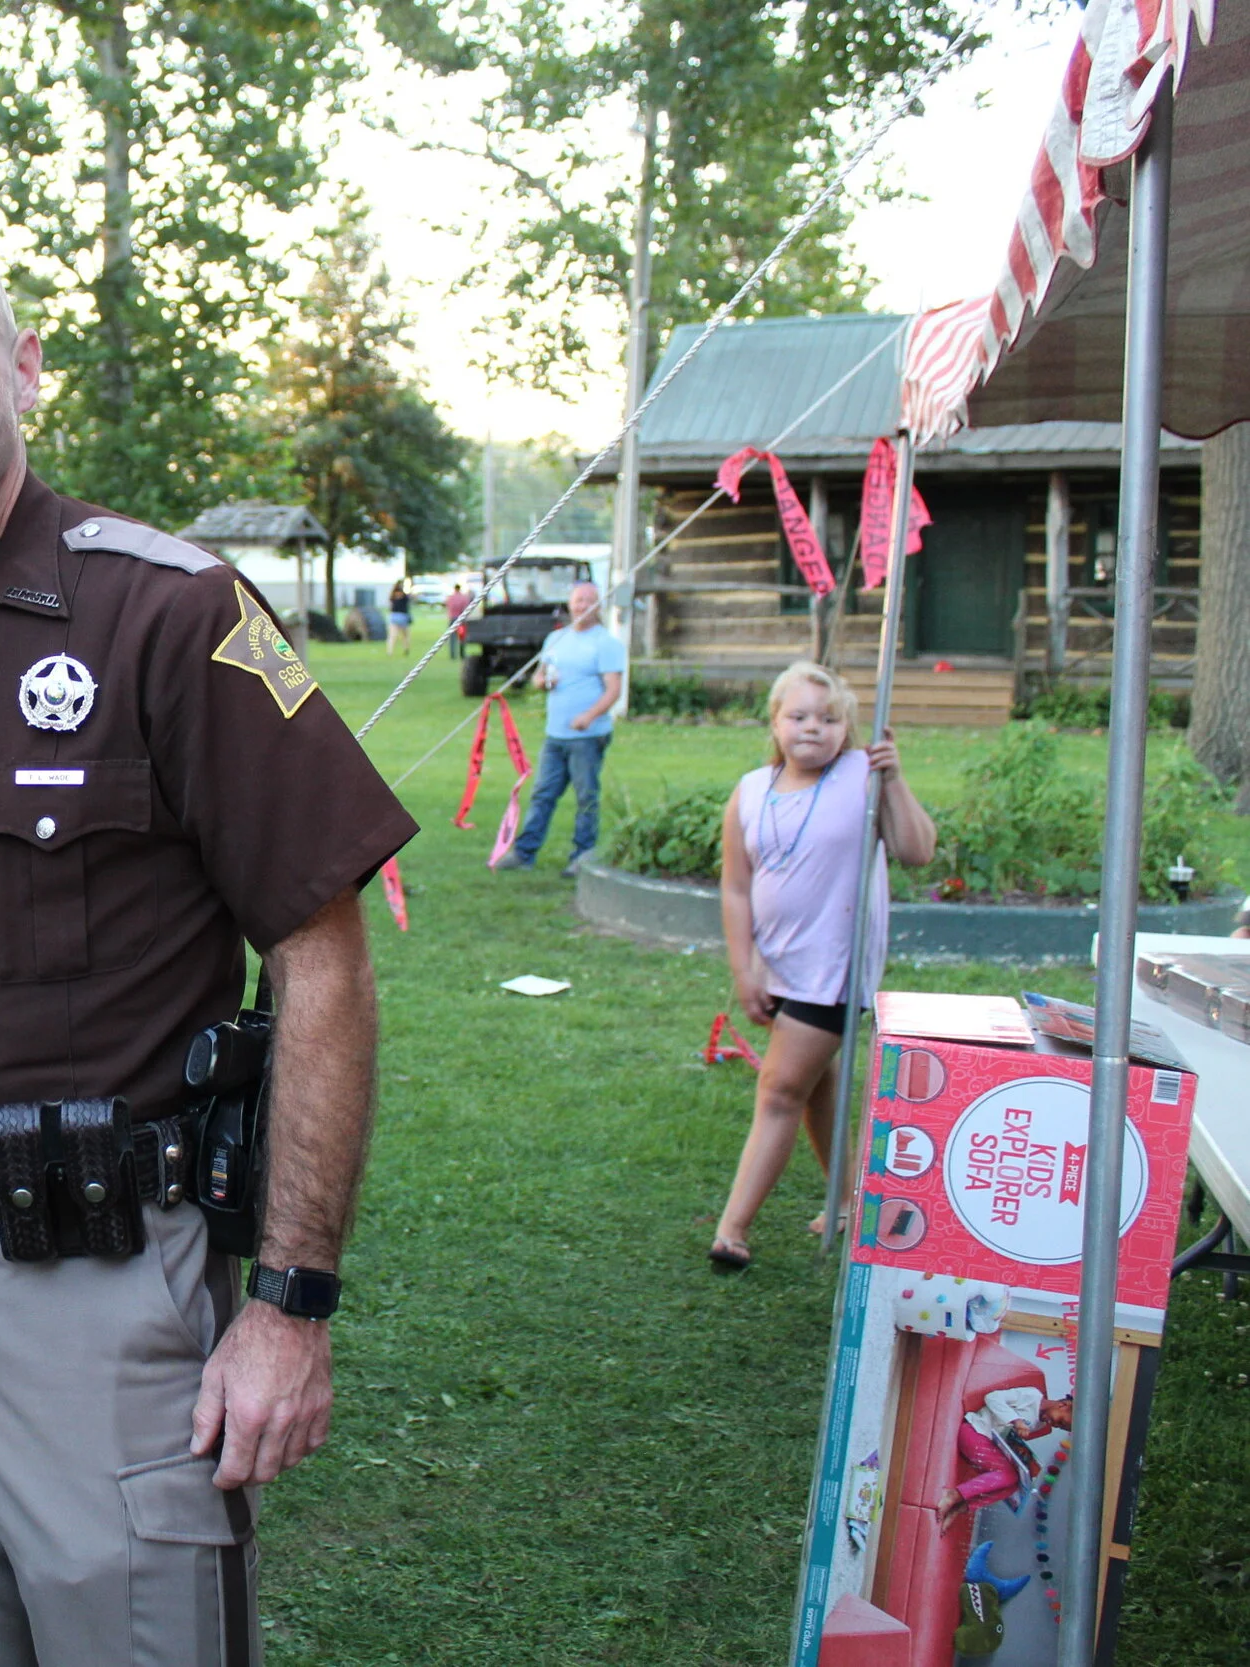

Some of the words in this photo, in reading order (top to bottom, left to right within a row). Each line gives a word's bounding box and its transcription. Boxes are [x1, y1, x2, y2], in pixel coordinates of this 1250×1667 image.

[278, 662, 306, 680] COU
[284, 672, 309, 689] INDI
[965, 1133, 999, 1190] SOFA
[991, 1108, 1032, 1226] EXPLORER
[1064, 1153, 1081, 1193] 4-PIECE
